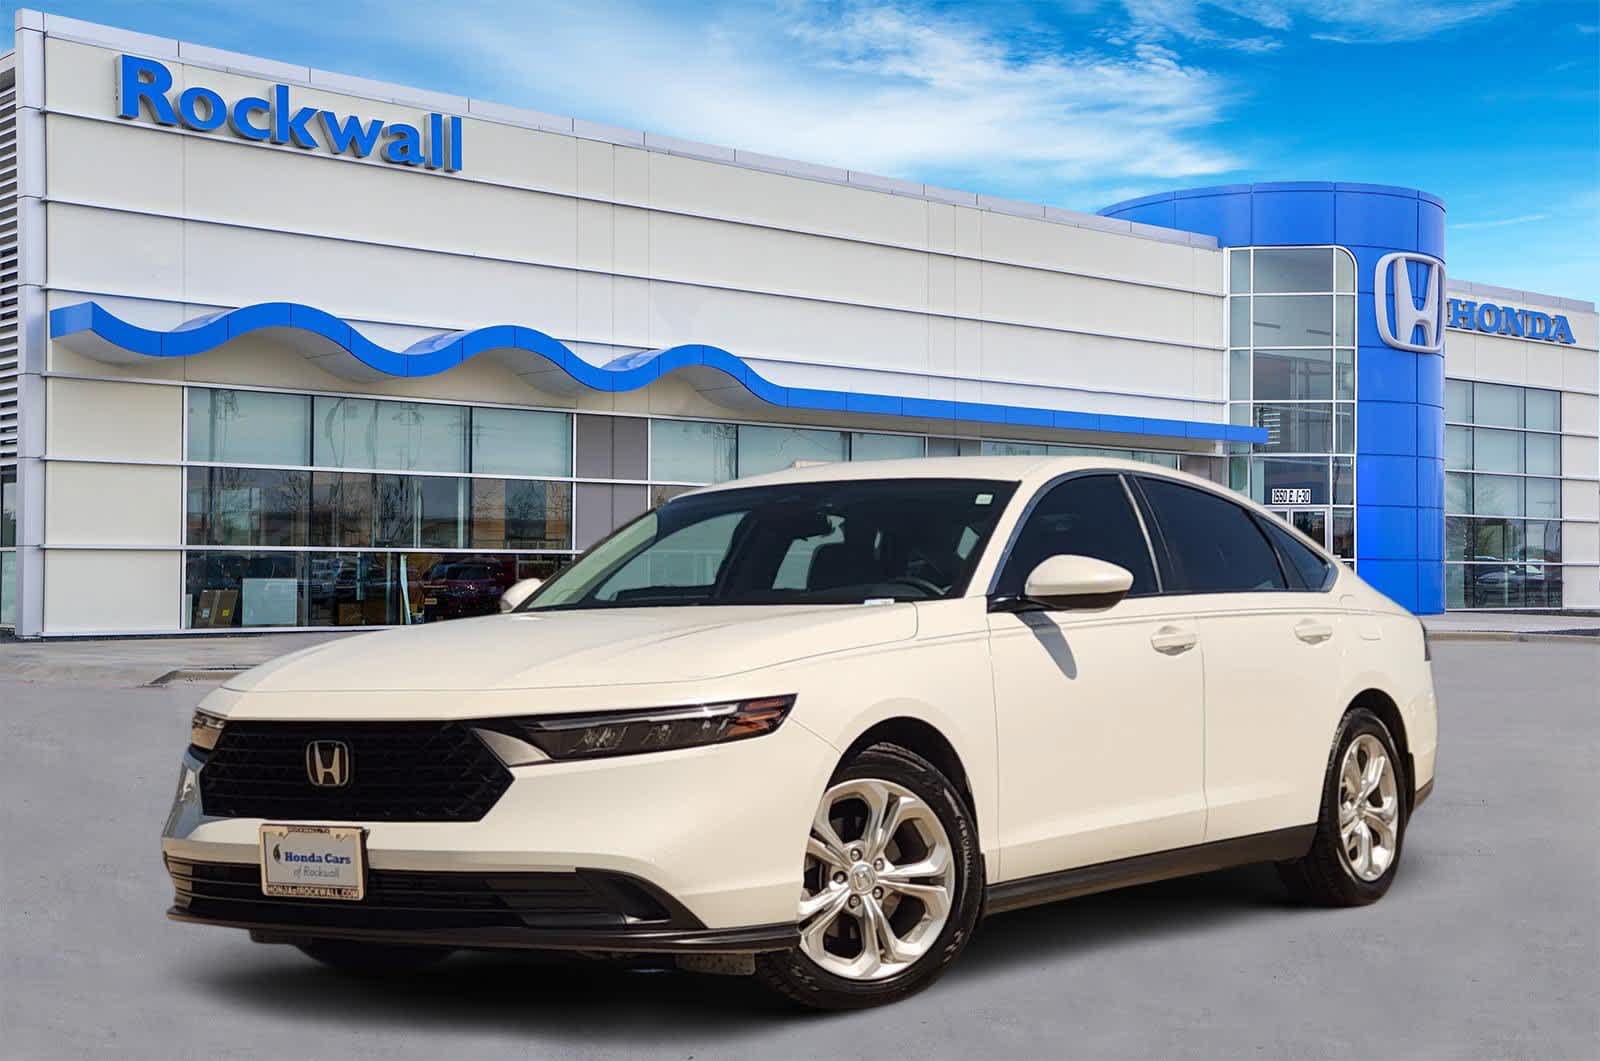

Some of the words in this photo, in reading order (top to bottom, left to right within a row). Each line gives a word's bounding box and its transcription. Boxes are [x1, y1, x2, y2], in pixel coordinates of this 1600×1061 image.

[116, 53, 463, 172] Rockwall
[1446, 298, 1577, 344] HONDA
[1273, 489, 1288, 503] 1550
[1296, 489, 1310, 503] I-30
[285, 851, 323, 863] Honda
[324, 853, 351, 864] Cars
[303, 865, 339, 878] Rockwall
